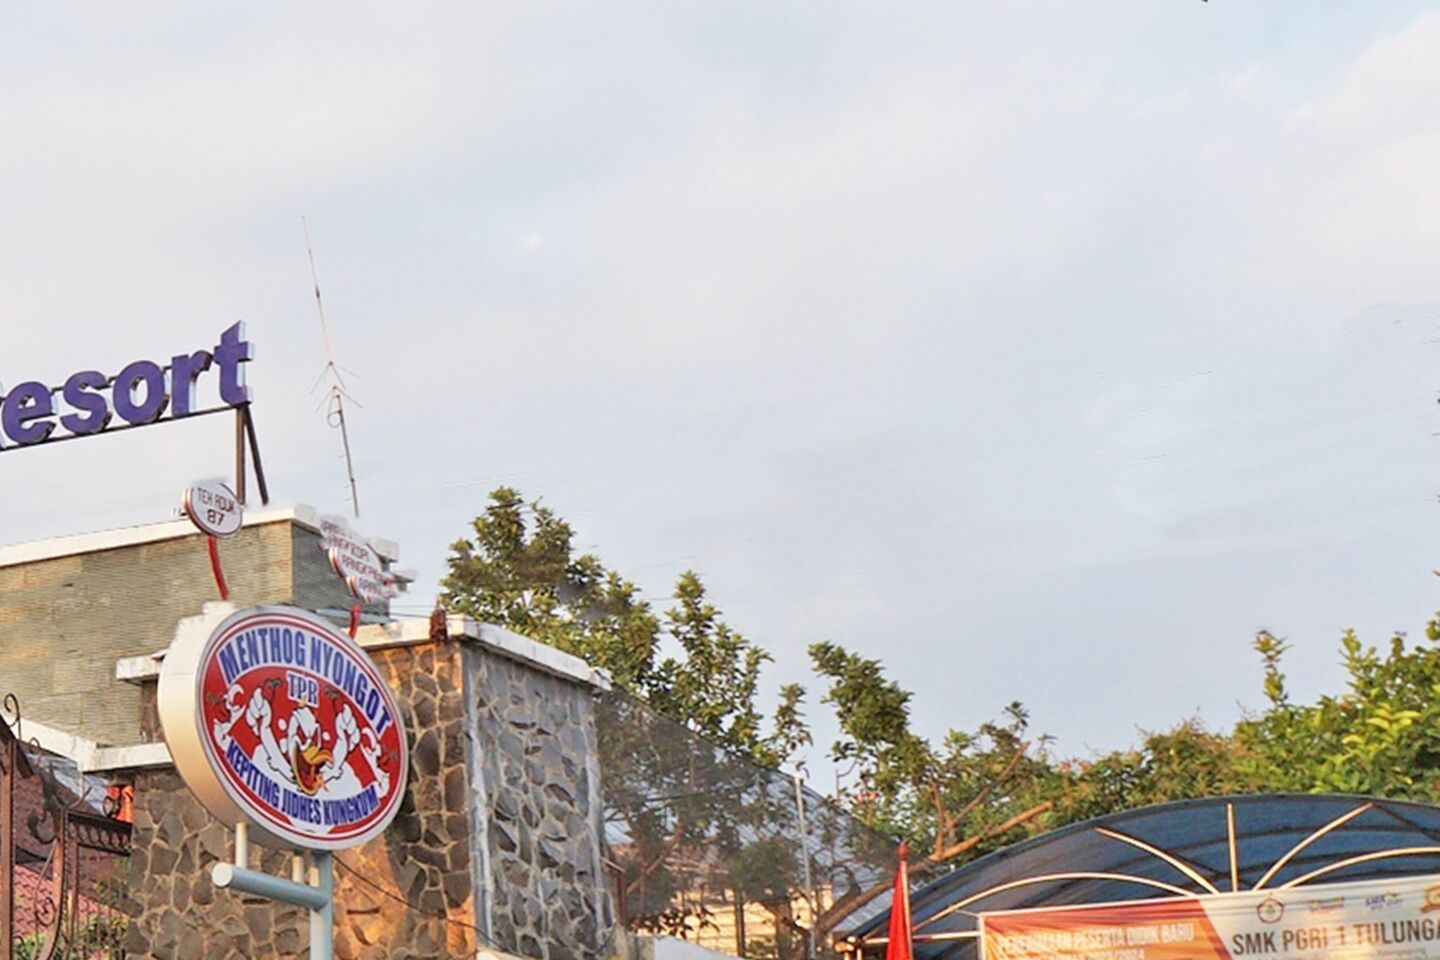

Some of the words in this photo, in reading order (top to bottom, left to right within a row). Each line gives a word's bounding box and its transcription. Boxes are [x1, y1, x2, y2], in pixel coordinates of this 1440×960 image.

[207, 508, 225, 526] 87
[218, 627, 306, 684] MENTHOG
[310, 636, 394, 735] NYONGOT
[287, 673, 318, 705] TPR
[226, 738, 280, 808] KEPITING
[323, 784, 380, 826] KUNGKUM
[1073, 928, 1126, 951] PESERTA
[1126, 925, 1158, 946] DIDIK
[1160, 923, 1195, 943] BARU
[1232, 931, 1277, 956] SMK
[1282, 927, 1329, 952] PGRI
[1335, 925, 1346, 946] 1
